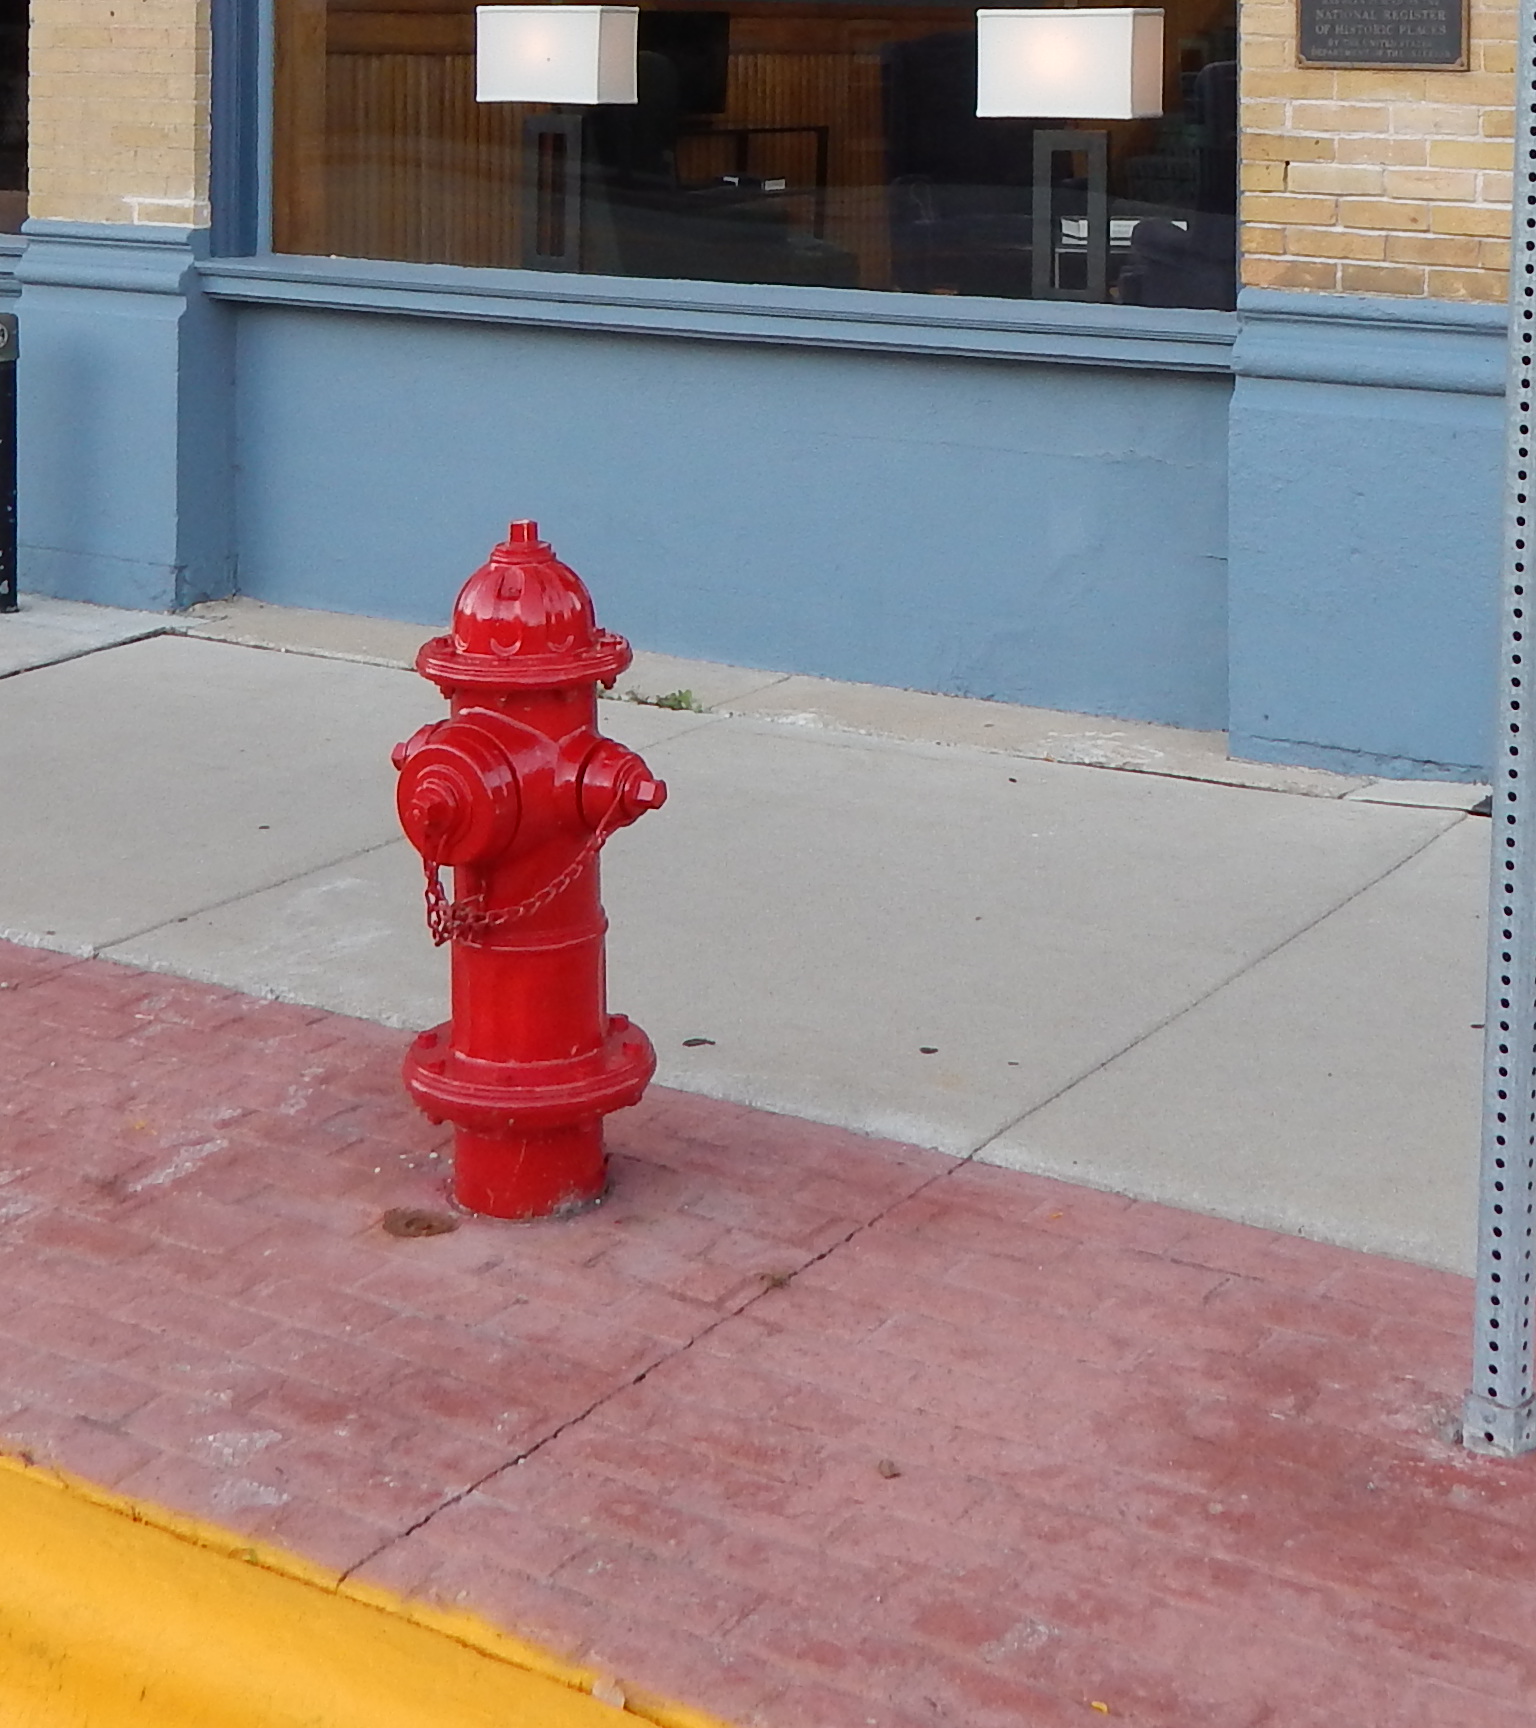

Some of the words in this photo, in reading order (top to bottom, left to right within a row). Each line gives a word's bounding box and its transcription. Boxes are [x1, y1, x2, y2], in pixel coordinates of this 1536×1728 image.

[1315, 9, 1377, 21] NATIONAL
[1384, 9, 1446, 21] REGISTER
[1315, 24, 1331, 35] OF
[1399, 24, 1447, 35] PLACES
